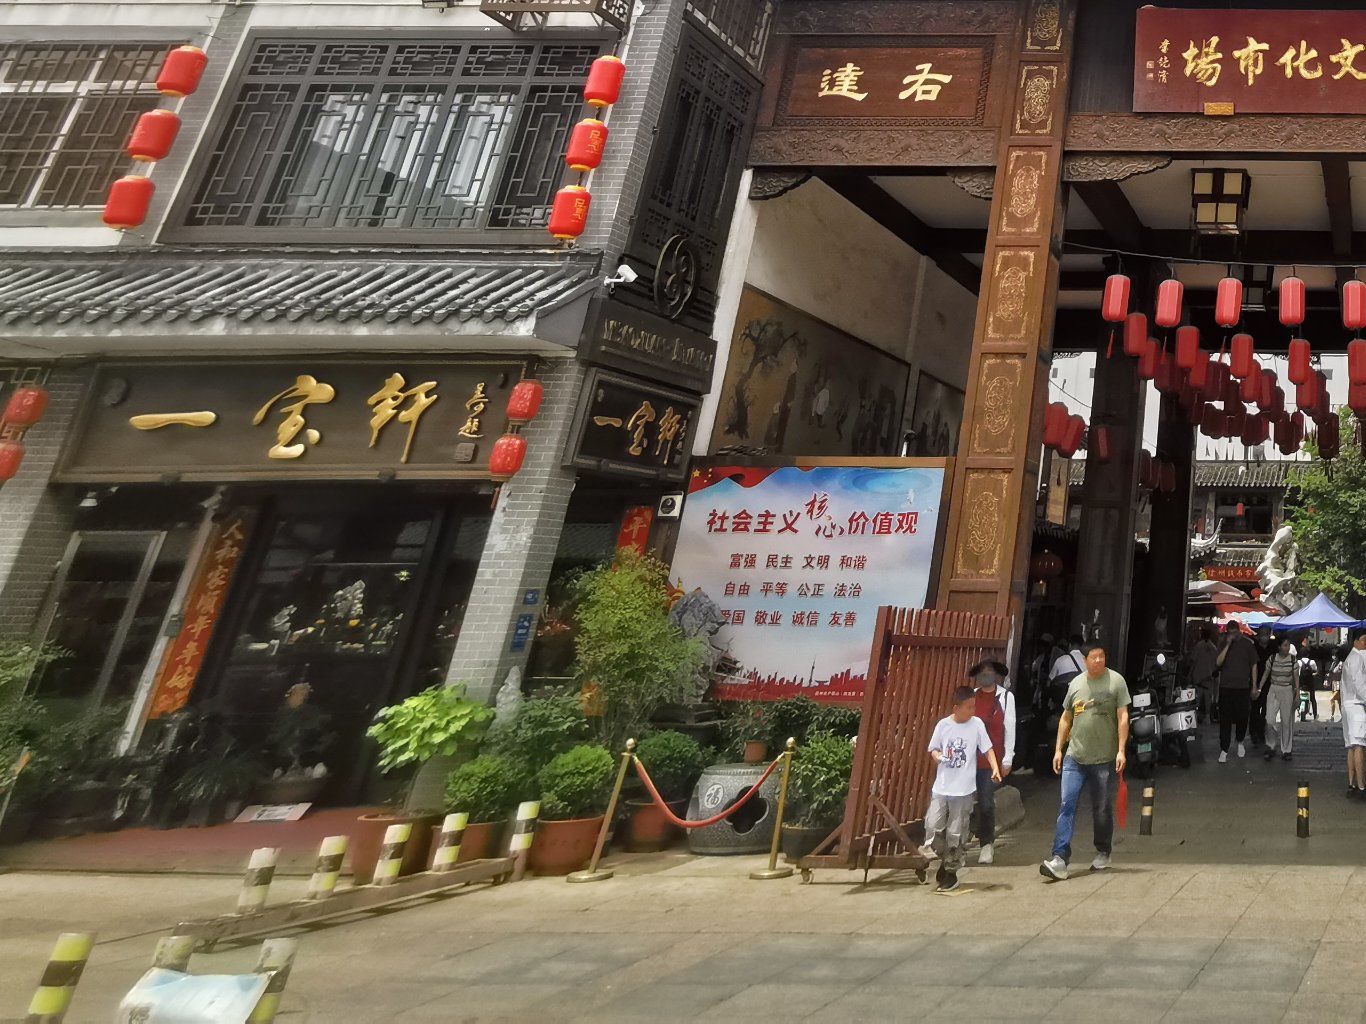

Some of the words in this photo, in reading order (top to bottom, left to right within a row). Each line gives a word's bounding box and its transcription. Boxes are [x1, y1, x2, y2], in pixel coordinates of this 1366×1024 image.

[729, 553, 757, 569] 富强
[766, 553, 793, 569] 民主
[802, 554, 829, 570] 文明
[839, 554, 867, 570] 和谐
[723, 581, 750, 597] 自由
[760, 581, 788, 597] 平等
[797, 582, 825, 597] 公正
[833, 582, 862, 598] 法治
[754, 609, 782, 626] 敬业
[791, 610, 820, 626] 诚信
[829, 610, 858, 627] 友善
